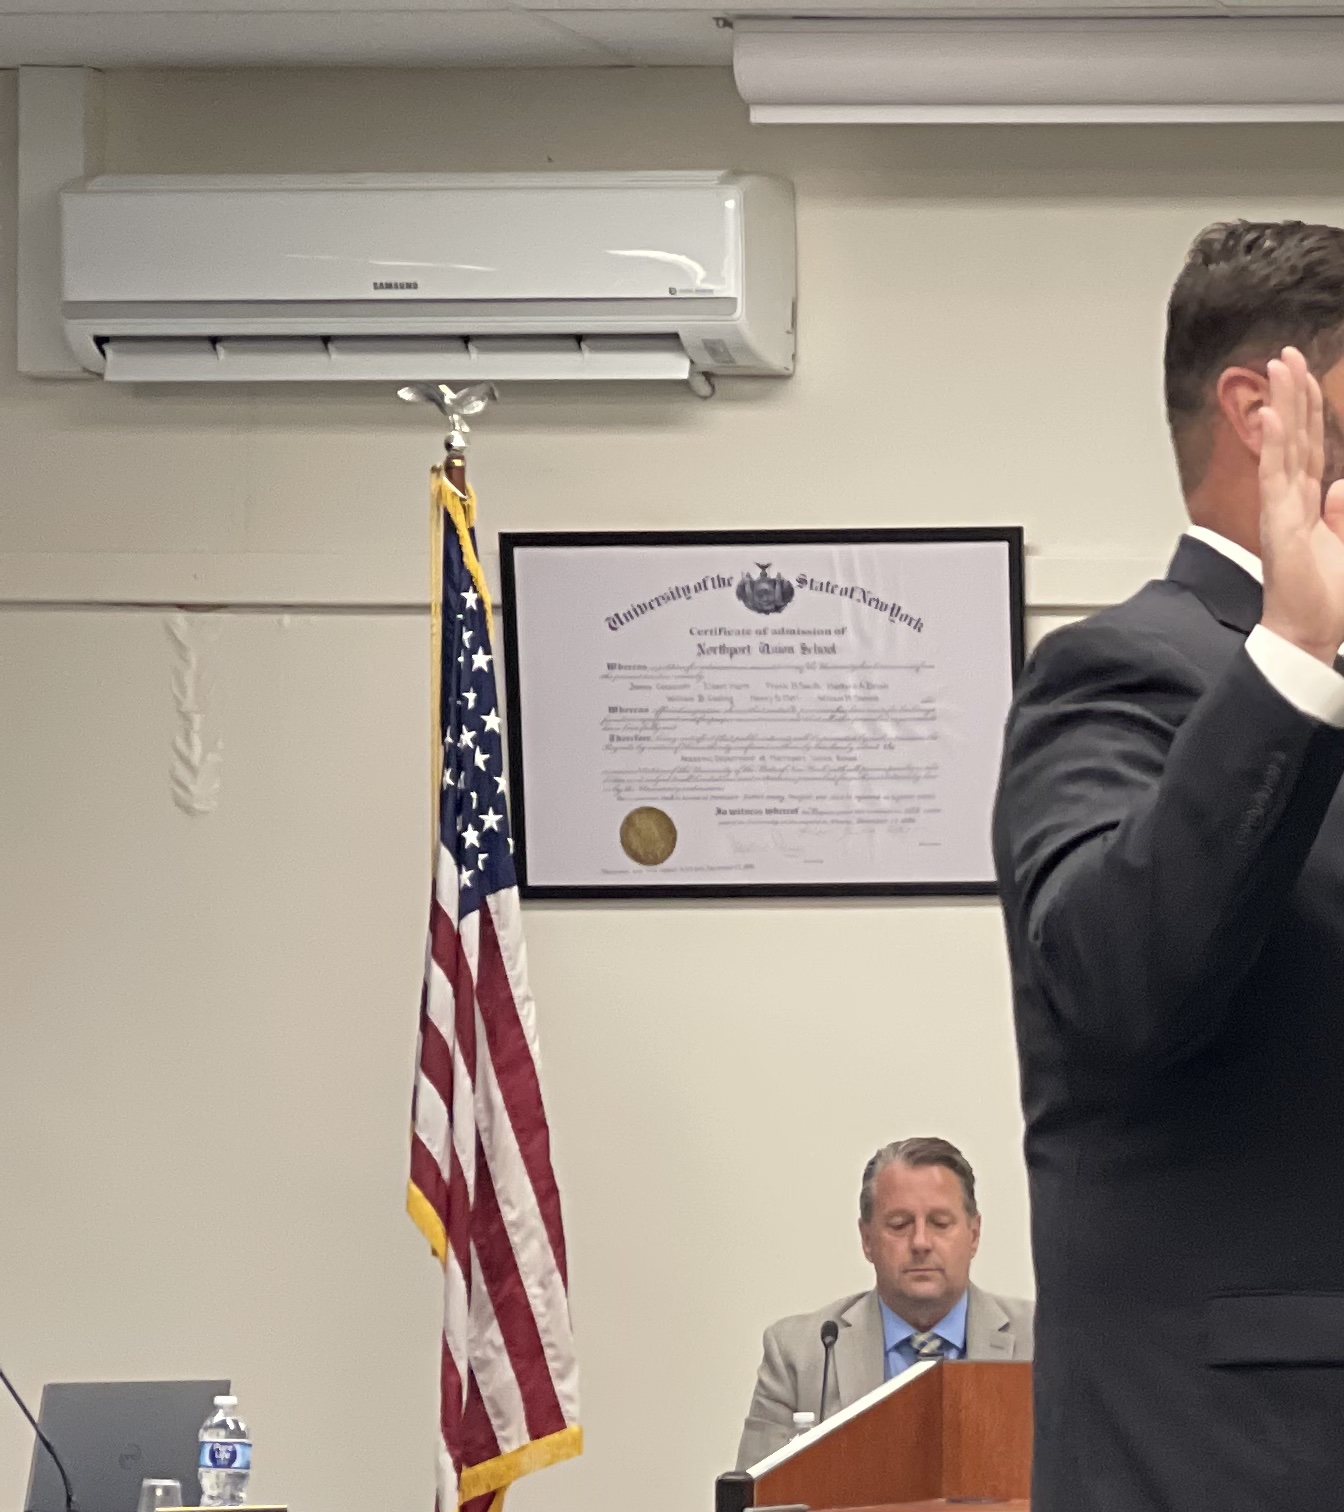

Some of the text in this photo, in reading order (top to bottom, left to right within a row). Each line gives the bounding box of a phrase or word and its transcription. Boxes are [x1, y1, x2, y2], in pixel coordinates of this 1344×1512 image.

[372, 281, 418, 290] SAMSUNG
[604, 584, 692, 631] University
[693, 575, 710, 594] of
[711, 574, 734, 590] the
[796, 573, 839, 595] State
[855, 587, 889, 612] New
[888, 602, 924, 633] York
[688, 626, 848, 637] Certificate of admission of
[696, 642, 837, 660] Northport Union School
